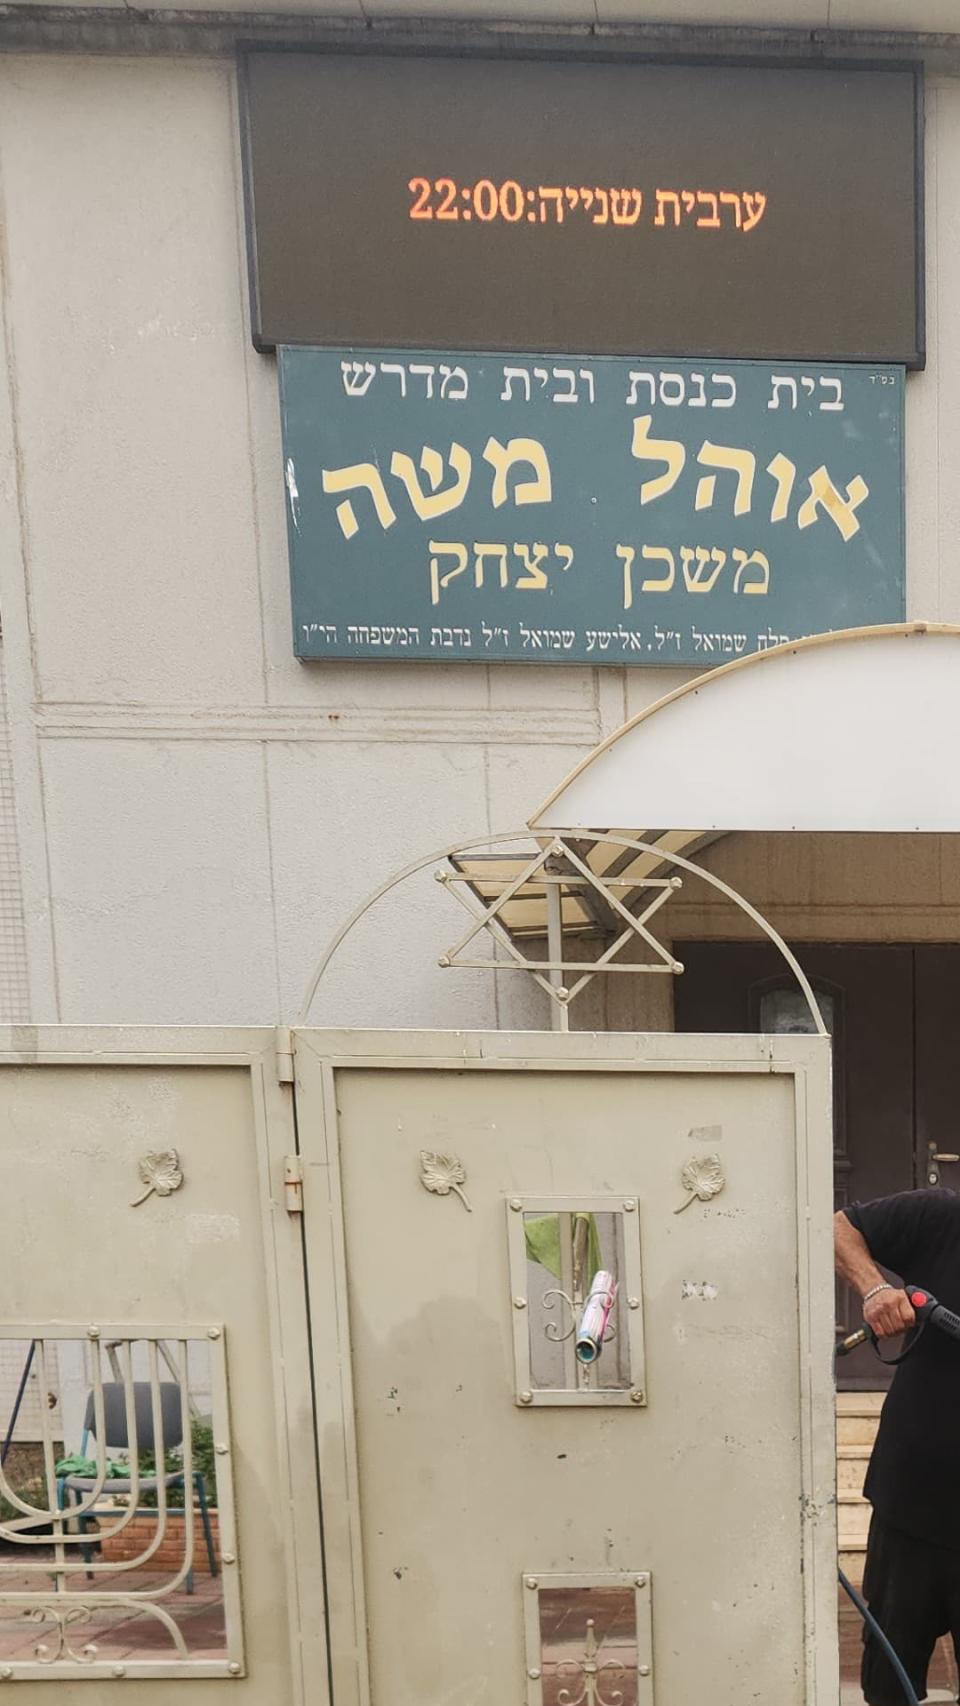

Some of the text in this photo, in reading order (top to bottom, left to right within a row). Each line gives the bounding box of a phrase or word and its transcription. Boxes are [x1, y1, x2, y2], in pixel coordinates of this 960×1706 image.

[654, 189, 766, 231] ערבית
[341, 361, 845, 410] בית כנסת ובית מדרש
[321, 414, 869, 543] אוהל משה
[429, 540, 770, 610] משכן יצחק
[348, 627, 420, 646] המשפחה
[431, 627, 472, 647] נדבת
[482, 621, 509, 647] ז"ל
[520, 622, 576, 649] שמואל
[586, 624, 641, 652] אלישע
[692, 626, 747, 652] שמואל
